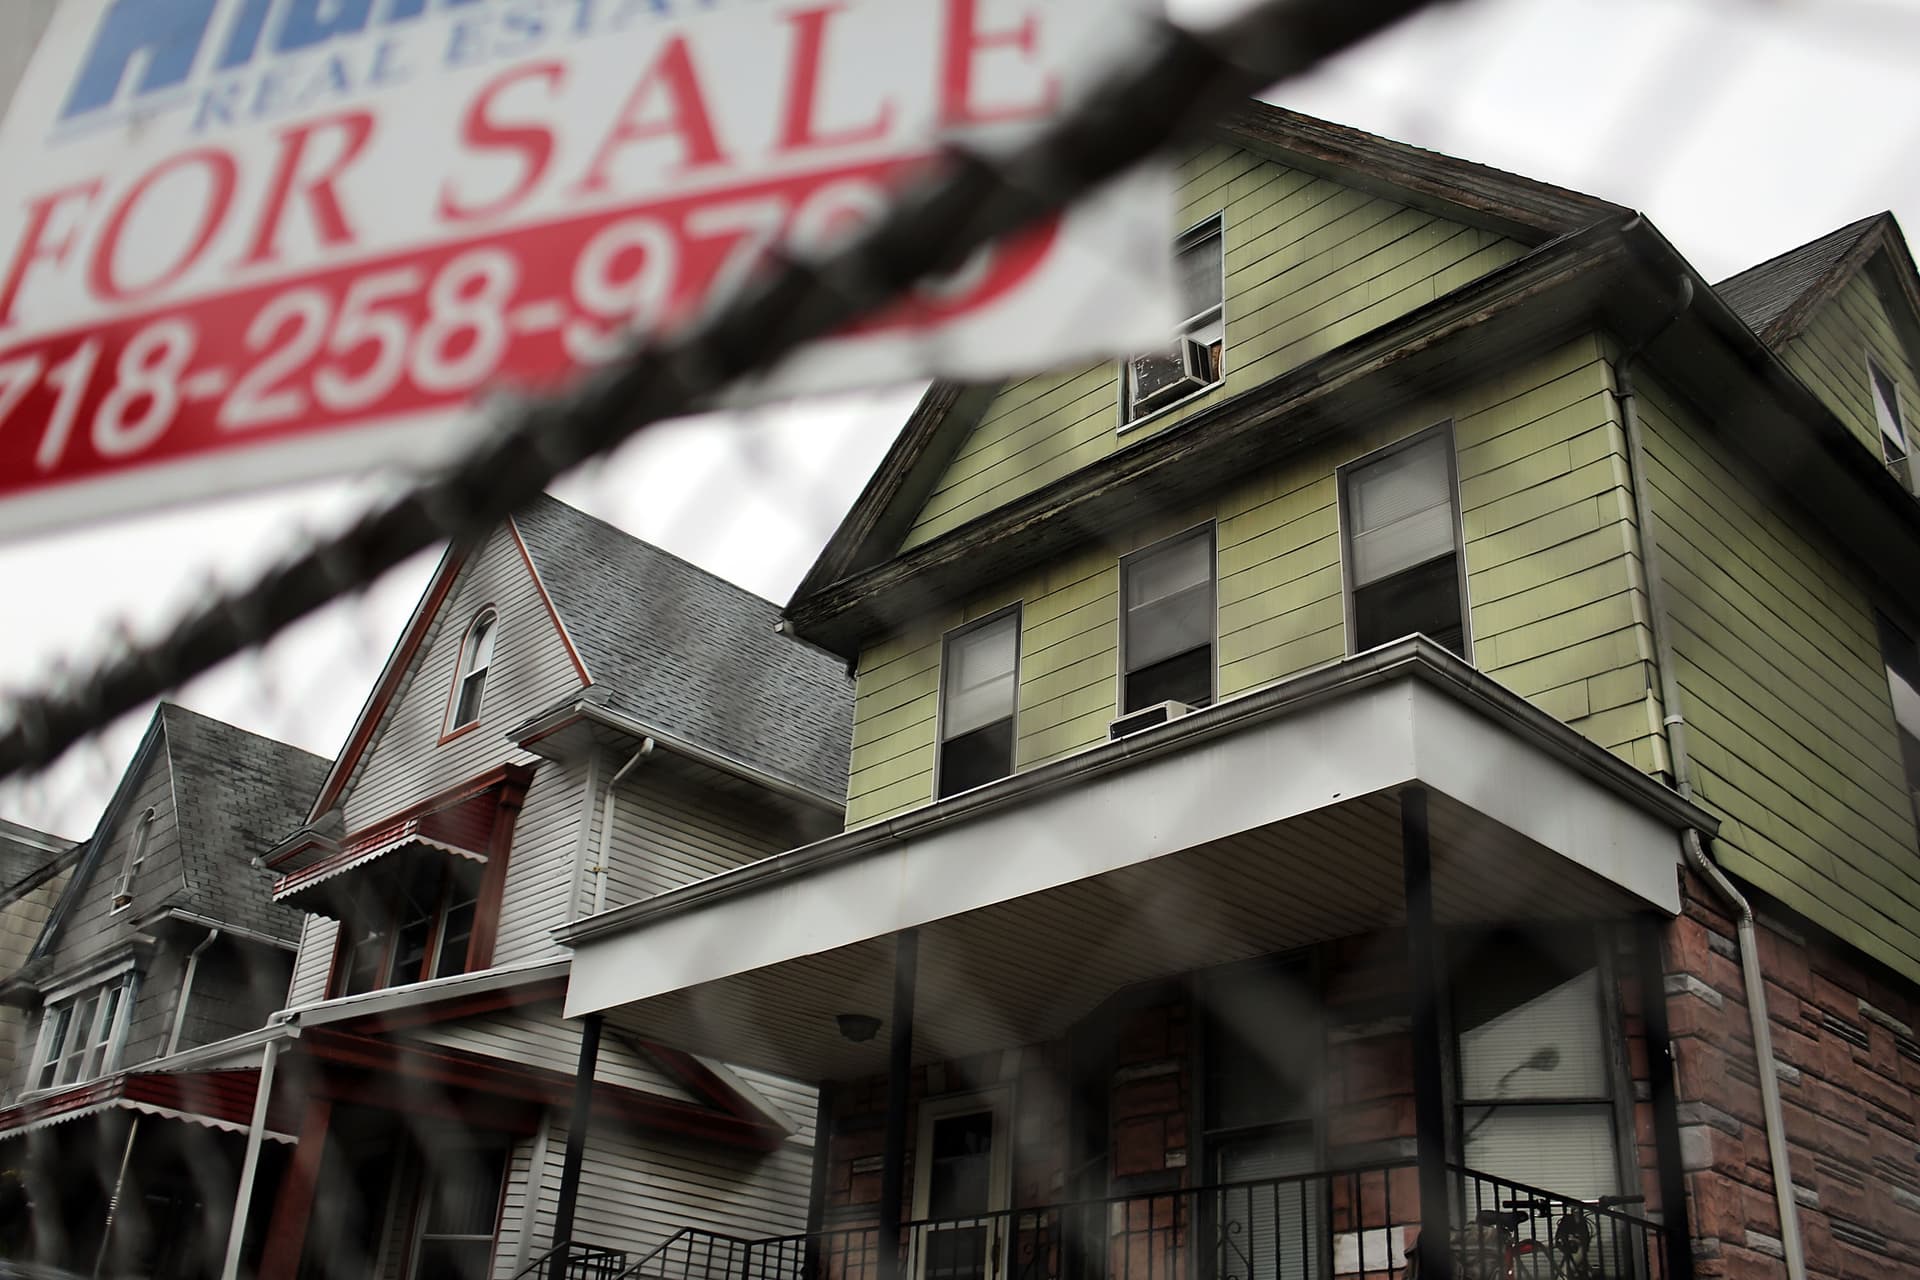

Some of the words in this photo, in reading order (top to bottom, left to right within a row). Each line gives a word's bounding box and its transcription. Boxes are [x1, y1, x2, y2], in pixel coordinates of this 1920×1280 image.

[0, 108, 376, 326] FOR
[433, 0, 1066, 224] SALE
[190, 38, 408, 134] REAL
